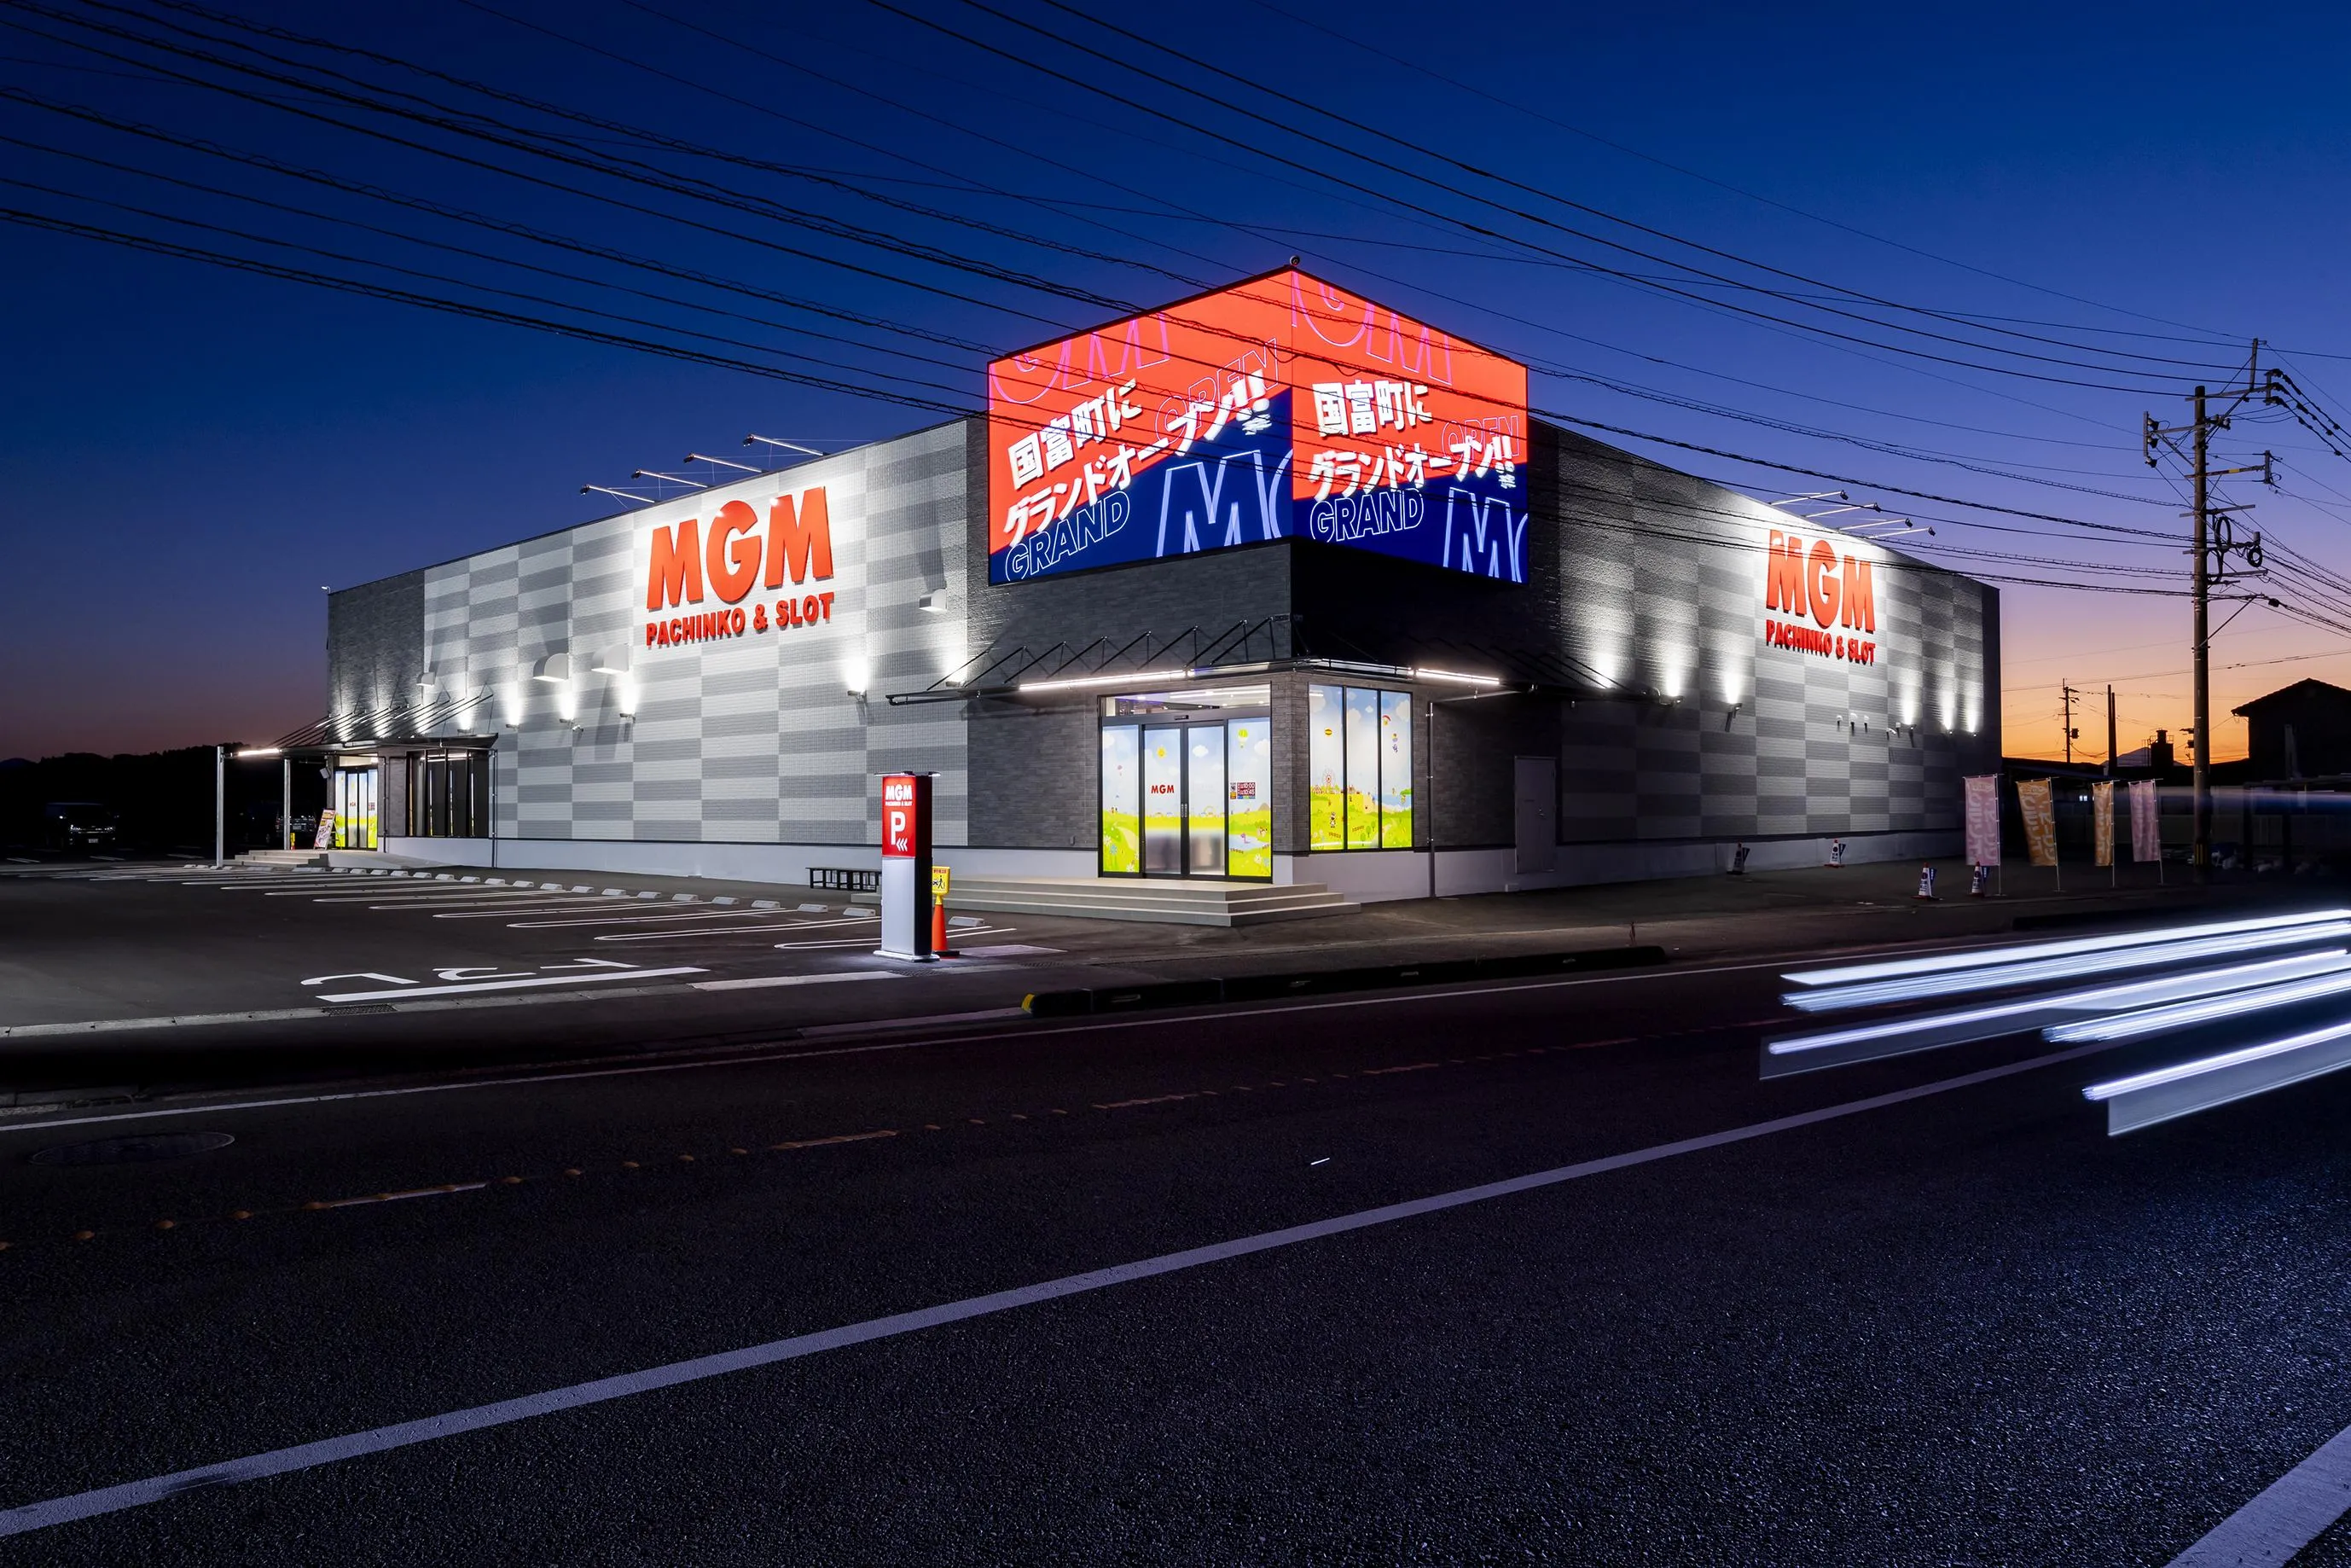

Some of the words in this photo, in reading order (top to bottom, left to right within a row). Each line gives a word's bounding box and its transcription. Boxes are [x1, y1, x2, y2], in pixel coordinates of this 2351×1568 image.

[1007, 378, 1143, 491] 国富町に
[1312, 379, 1433, 438] 国富町に
[1005, 490, 1130, 582] GRAND
[1309, 487, 1425, 543] GRAND
[647, 486, 834, 611] MGM
[1766, 529, 1876, 633] MGM
[646, 607, 746, 648] PACHINKO
[753, 602, 769, 630] &
[775, 591, 835, 627] SLOT
[1766, 618, 1833, 657] PACHINKO
[1836, 635, 1845, 659] &
[1848, 638, 1876, 665] SLOT
[885, 784, 912, 800] MGM
[1151, 784, 1175, 794] MGM
[891, 810, 906, 845] P
